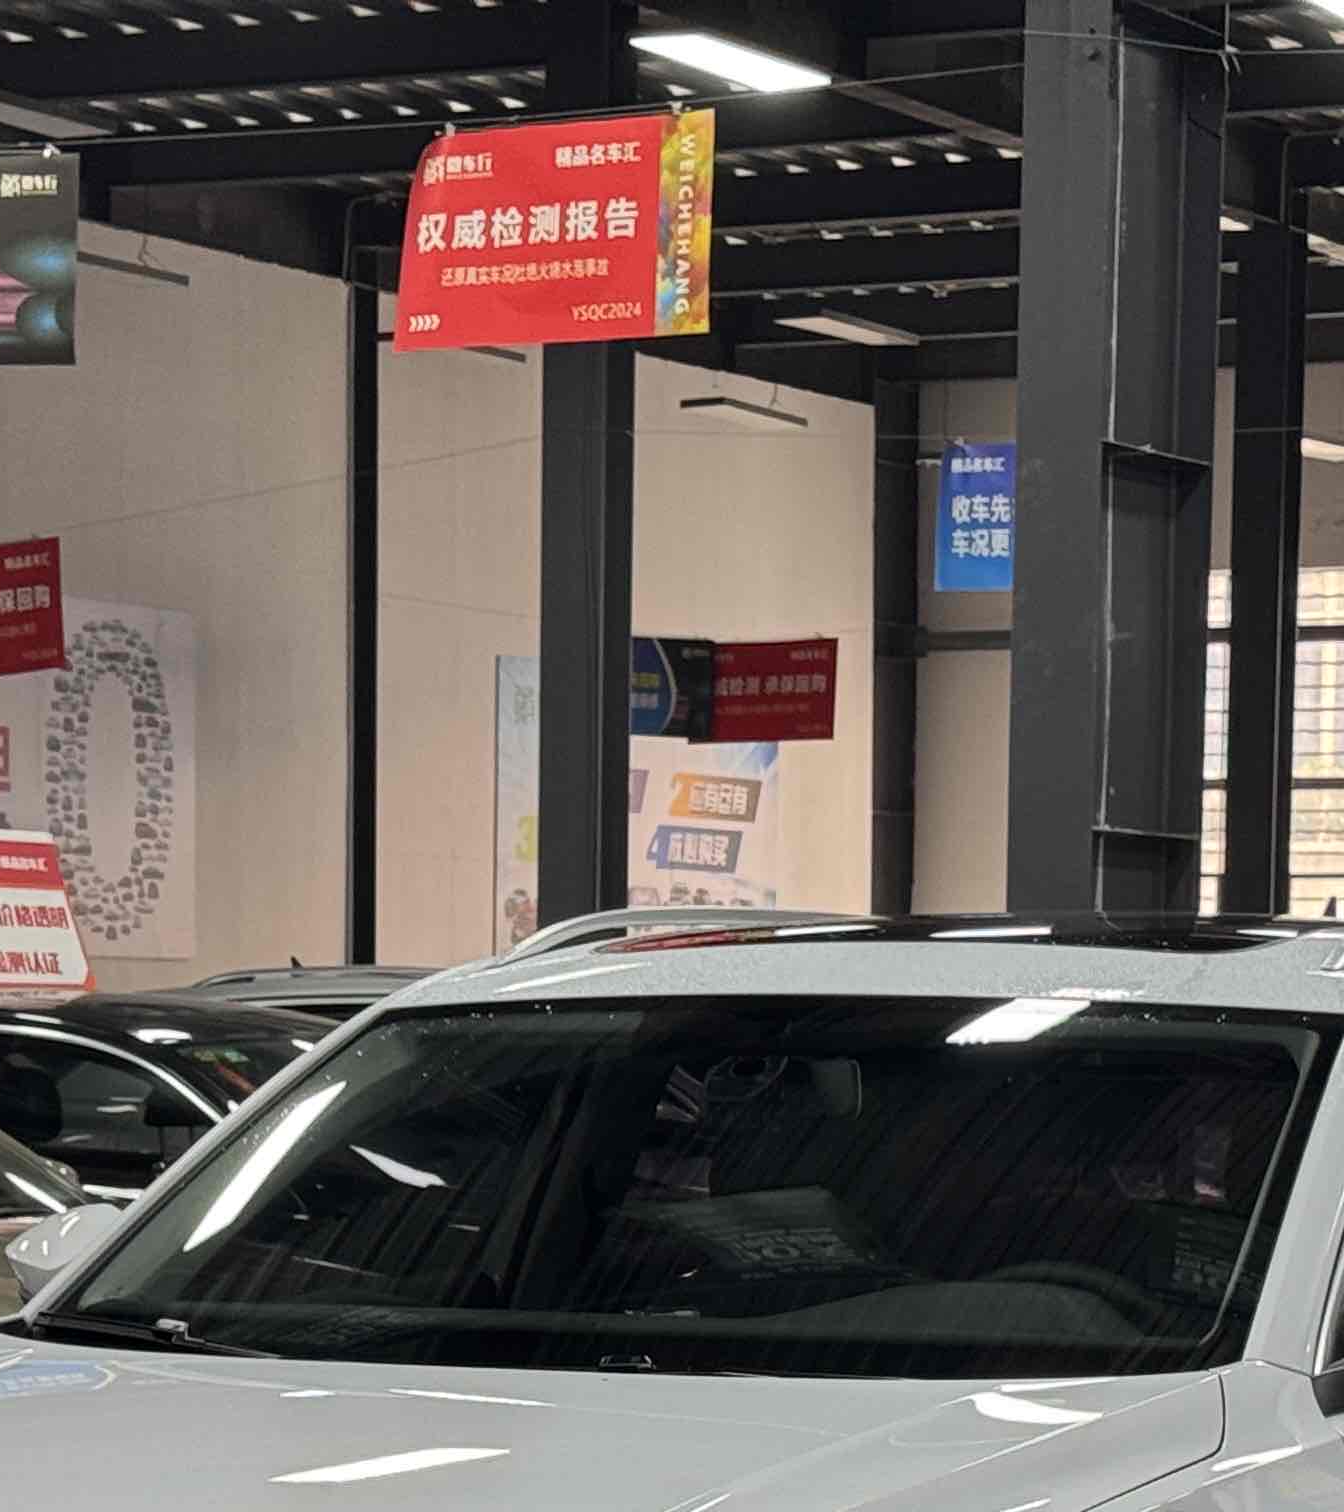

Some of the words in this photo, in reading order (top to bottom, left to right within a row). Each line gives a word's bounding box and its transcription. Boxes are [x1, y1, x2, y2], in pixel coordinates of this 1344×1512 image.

[555, 142, 641, 168] 精品名车汇
[417, 198, 640, 253] 权威检测报告
[572, 302, 642, 321] YSQC2024
